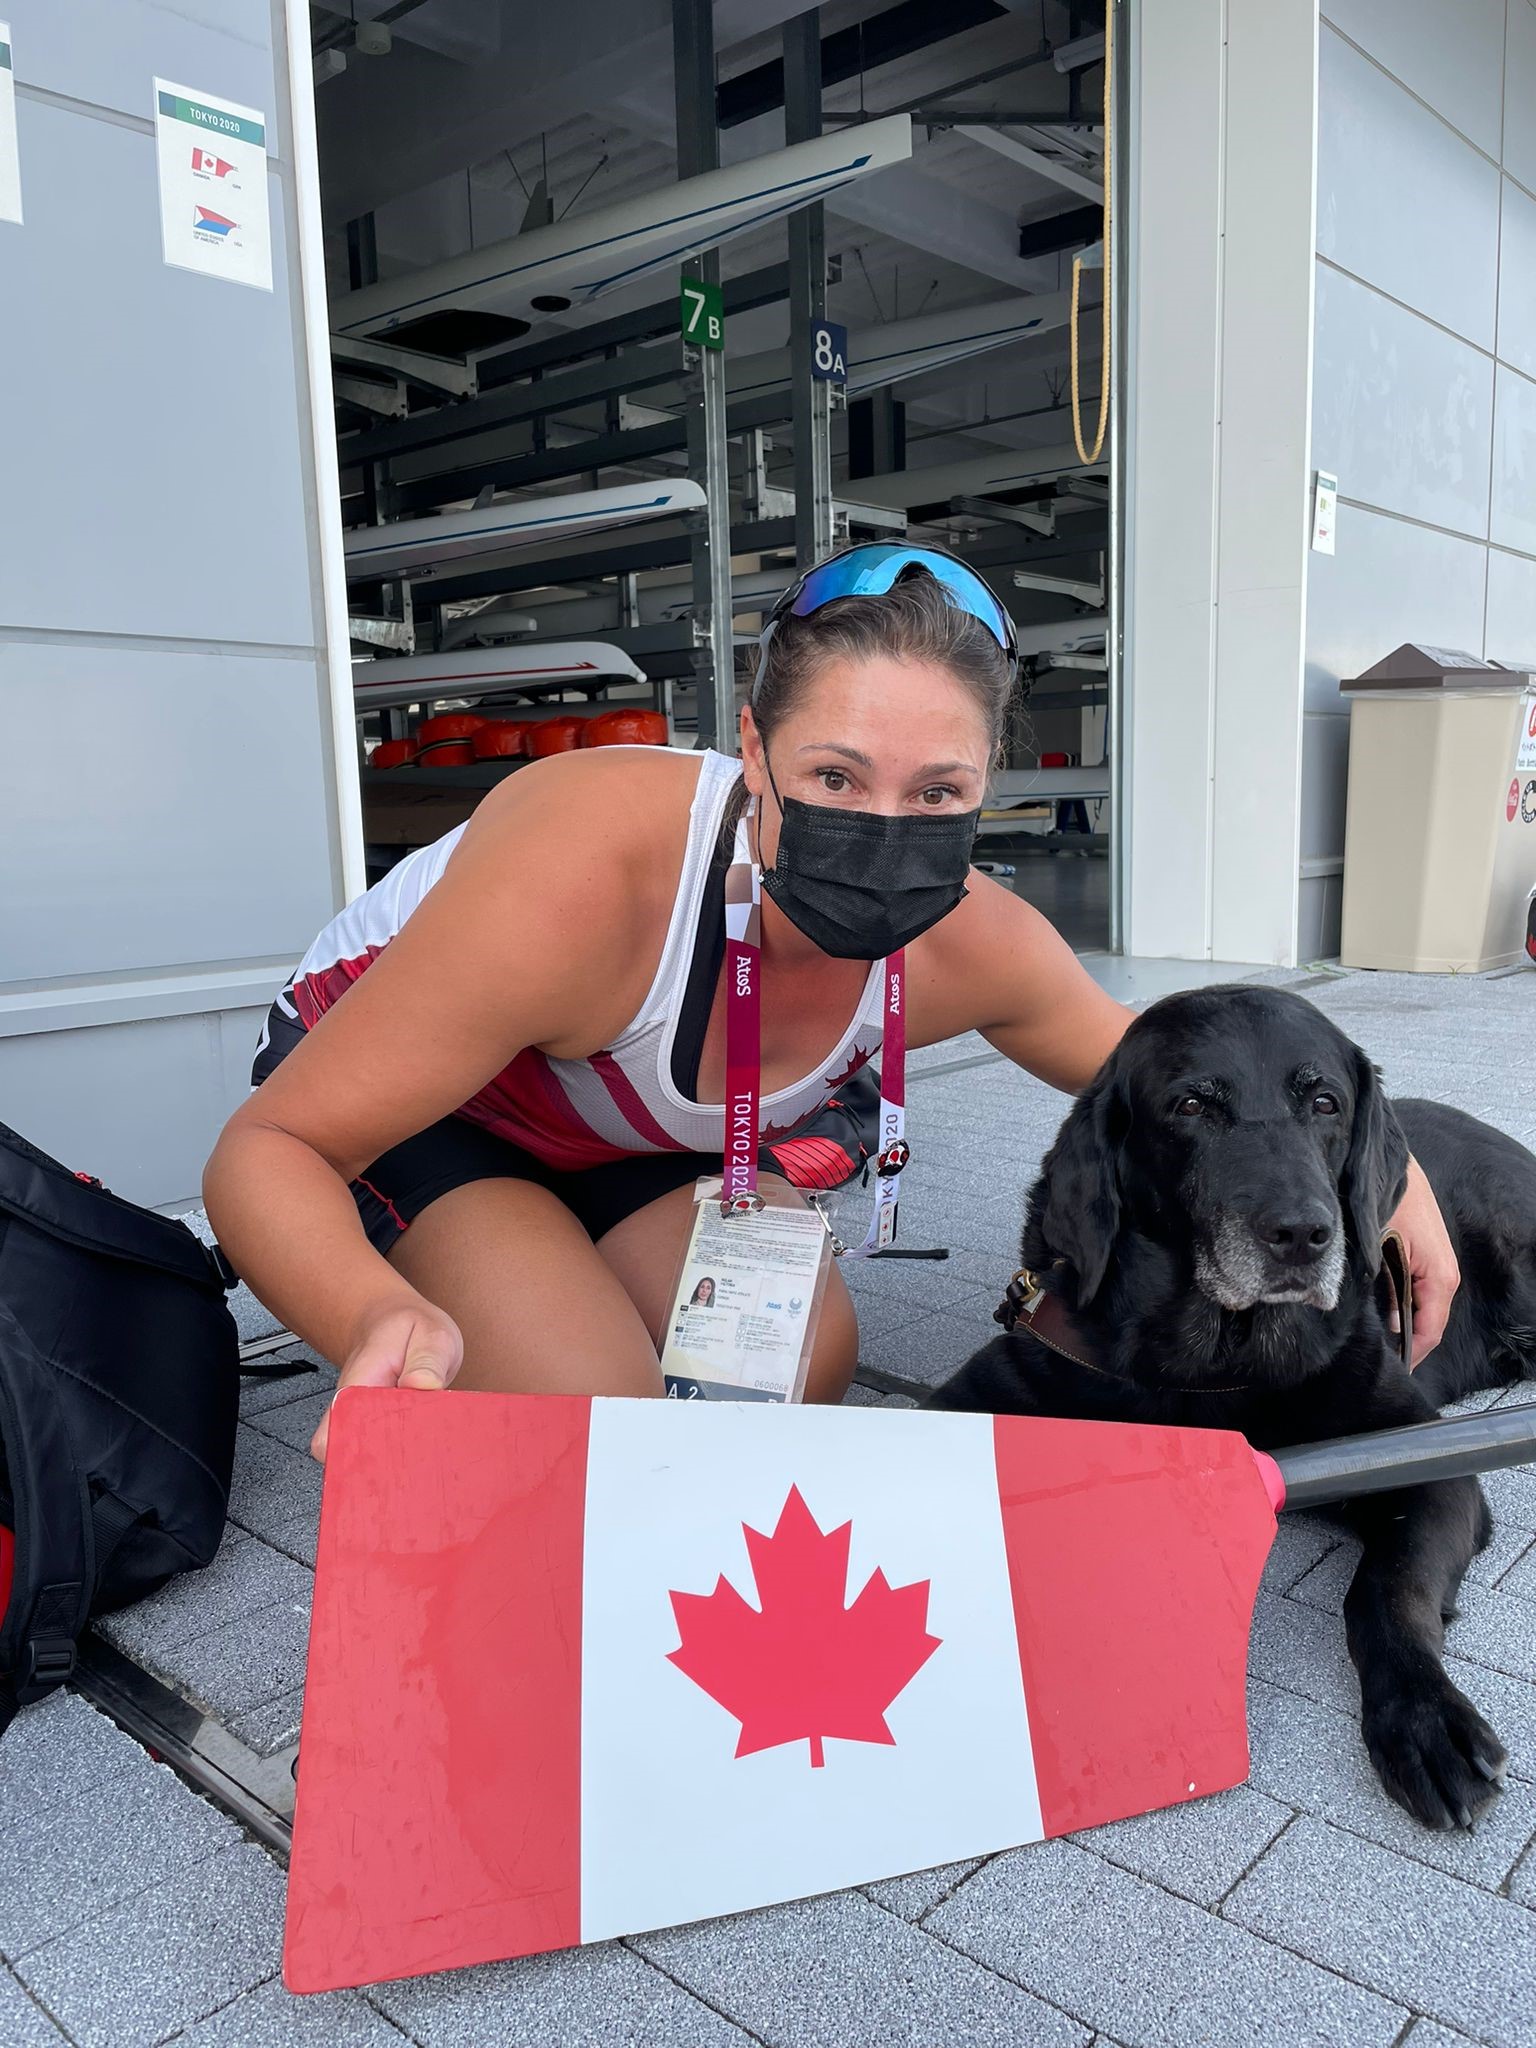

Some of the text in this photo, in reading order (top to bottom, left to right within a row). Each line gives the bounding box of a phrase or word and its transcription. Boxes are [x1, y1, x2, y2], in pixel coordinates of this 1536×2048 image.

[190, 107, 240, 133] TOKYO 2020
[736, 955, 752, 997] Atos
[890, 973, 900, 1016] Atos
[733, 1091, 752, 1151] TOKYO
[667, 1382, 699, 1400] A 2
